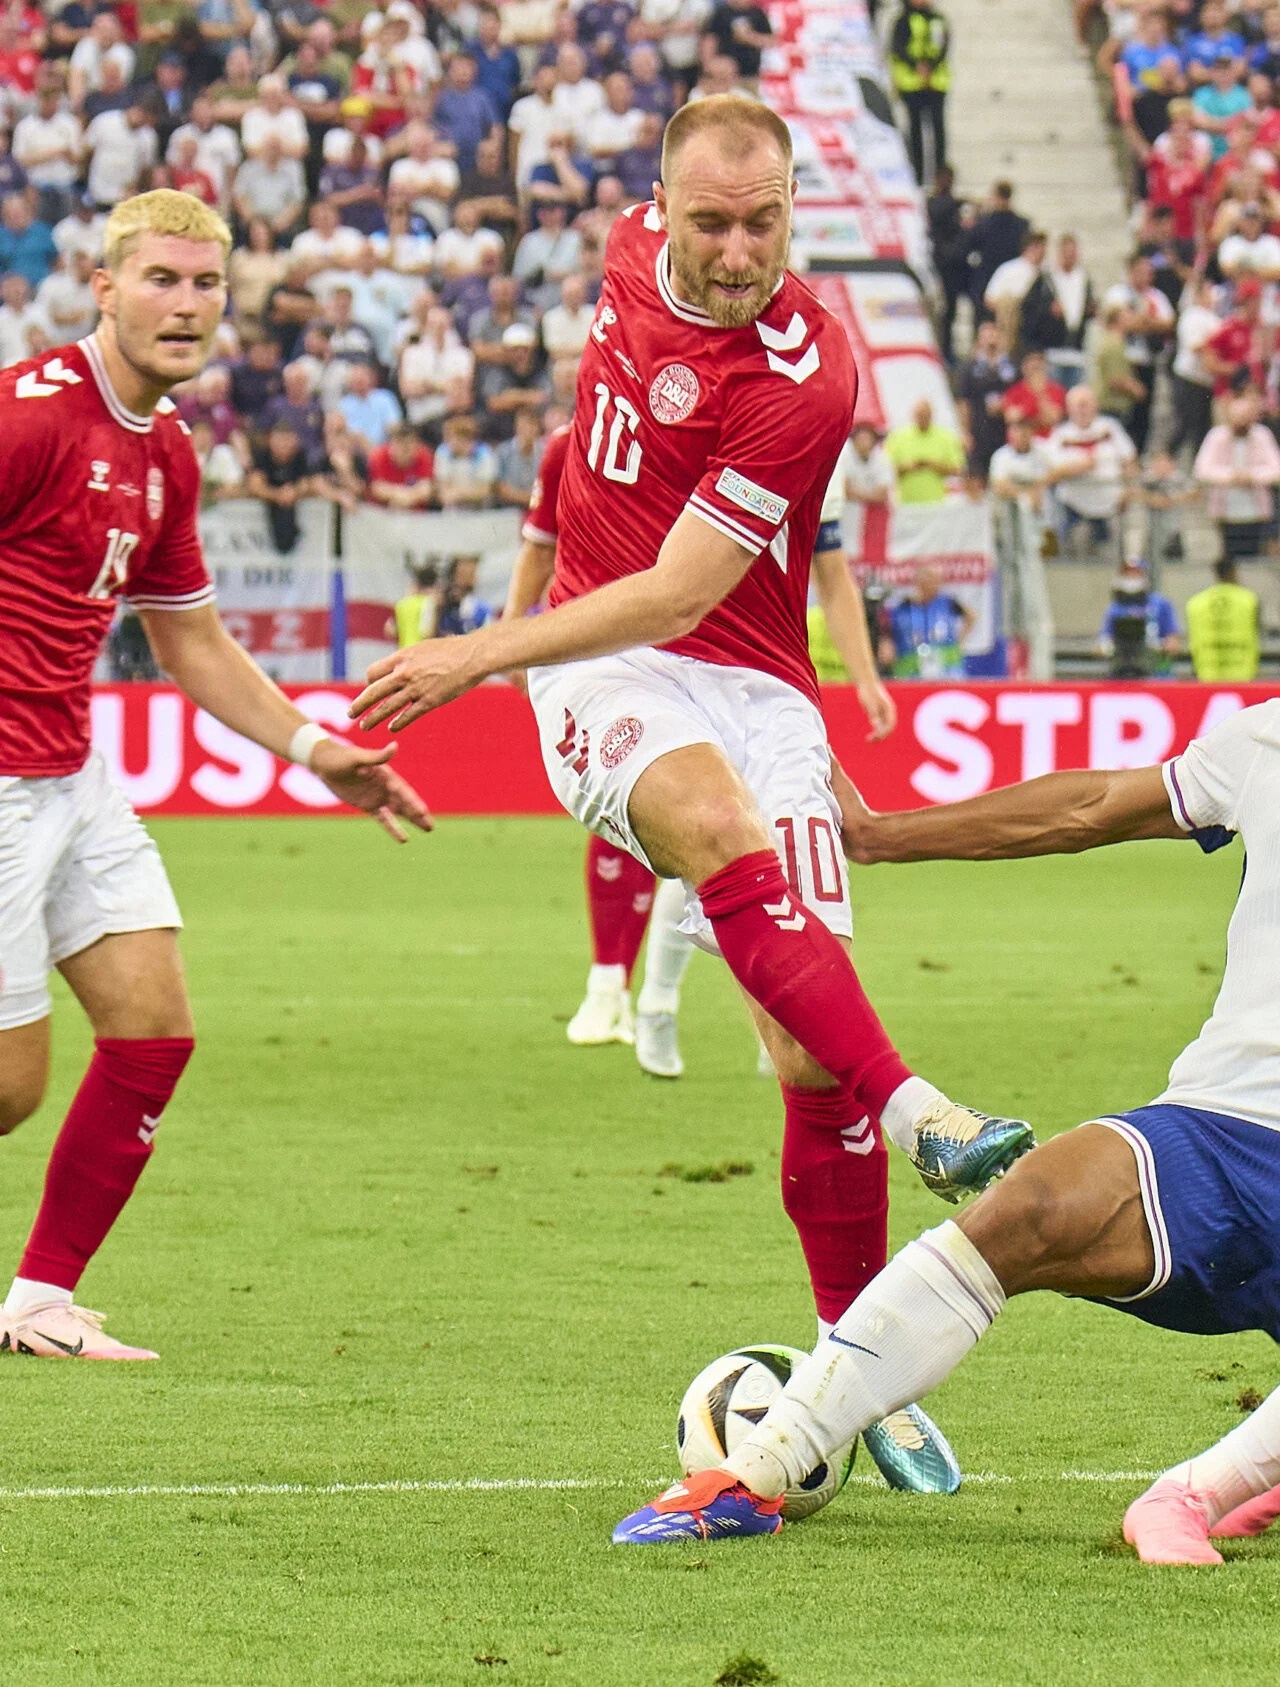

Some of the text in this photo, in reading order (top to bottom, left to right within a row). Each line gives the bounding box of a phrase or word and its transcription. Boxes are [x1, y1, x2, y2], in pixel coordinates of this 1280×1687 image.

[587, 382, 643, 485] 10
[721, 475, 784, 517] FOUNDATION
[775, 816, 844, 904] 10
